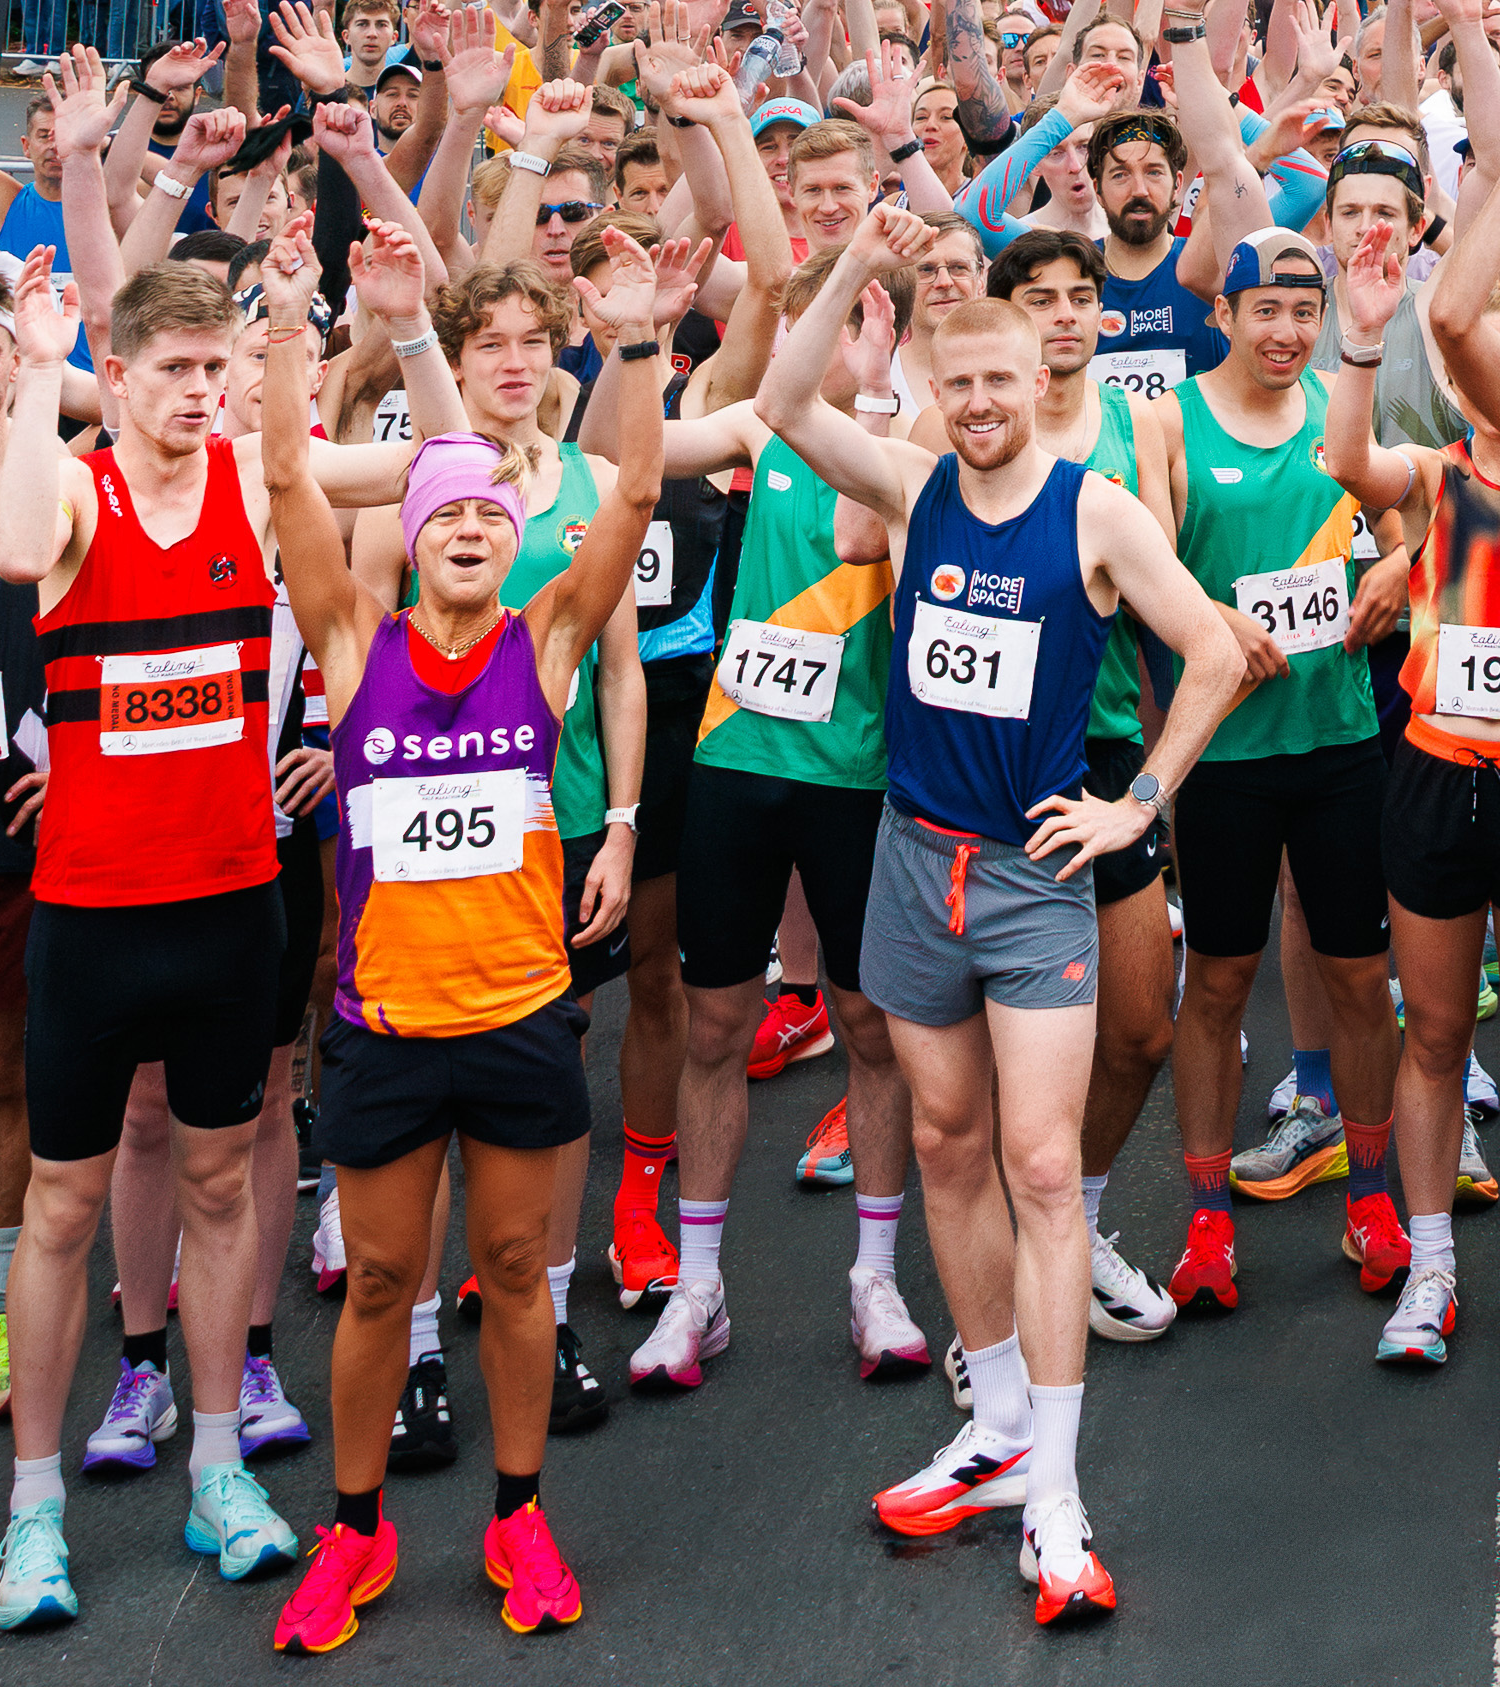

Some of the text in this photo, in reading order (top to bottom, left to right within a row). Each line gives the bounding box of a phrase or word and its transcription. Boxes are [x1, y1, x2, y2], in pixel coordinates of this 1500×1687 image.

[760, 105, 803, 123] HOKA
[1133, 308, 1170, 323] MORE
[1133, 320, 1170, 334] SPACE
[974, 571, 1020, 594] MORE
[1271, 574, 1320, 589] Ealing
[970, 589, 1018, 611] SPACE
[1252, 586, 1340, 634] 3146
[944, 616, 999, 640] Ealing
[144, 660, 205, 675] Ealing
[736, 649, 827, 696] 1747
[927, 638, 1001, 689] 631
[126, 682, 222, 724] 8338
[226, 673, 235, 718] NO MEDAL
[111, 685, 120, 731] NO MEDAL
[403, 725, 535, 760] sense
[417, 782, 483, 799] Ealing
[402, 806, 496, 852] 495
